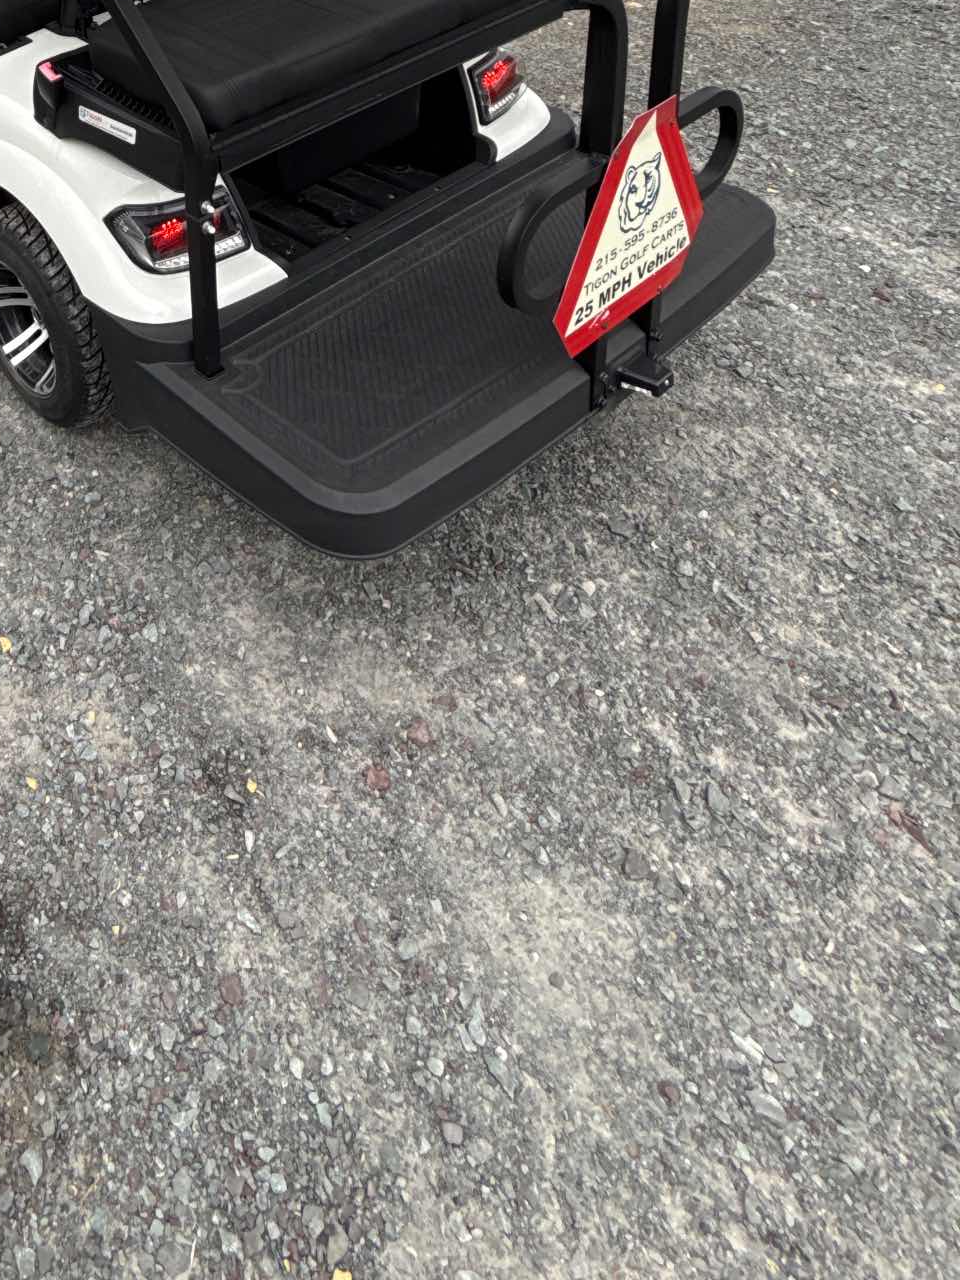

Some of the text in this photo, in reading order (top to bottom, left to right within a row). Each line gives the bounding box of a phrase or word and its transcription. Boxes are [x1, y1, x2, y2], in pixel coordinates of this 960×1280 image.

[575, 237, 686, 325] 25 MPH Vehicle
[584, 221, 684, 296] TIGON GOLF CARTS
